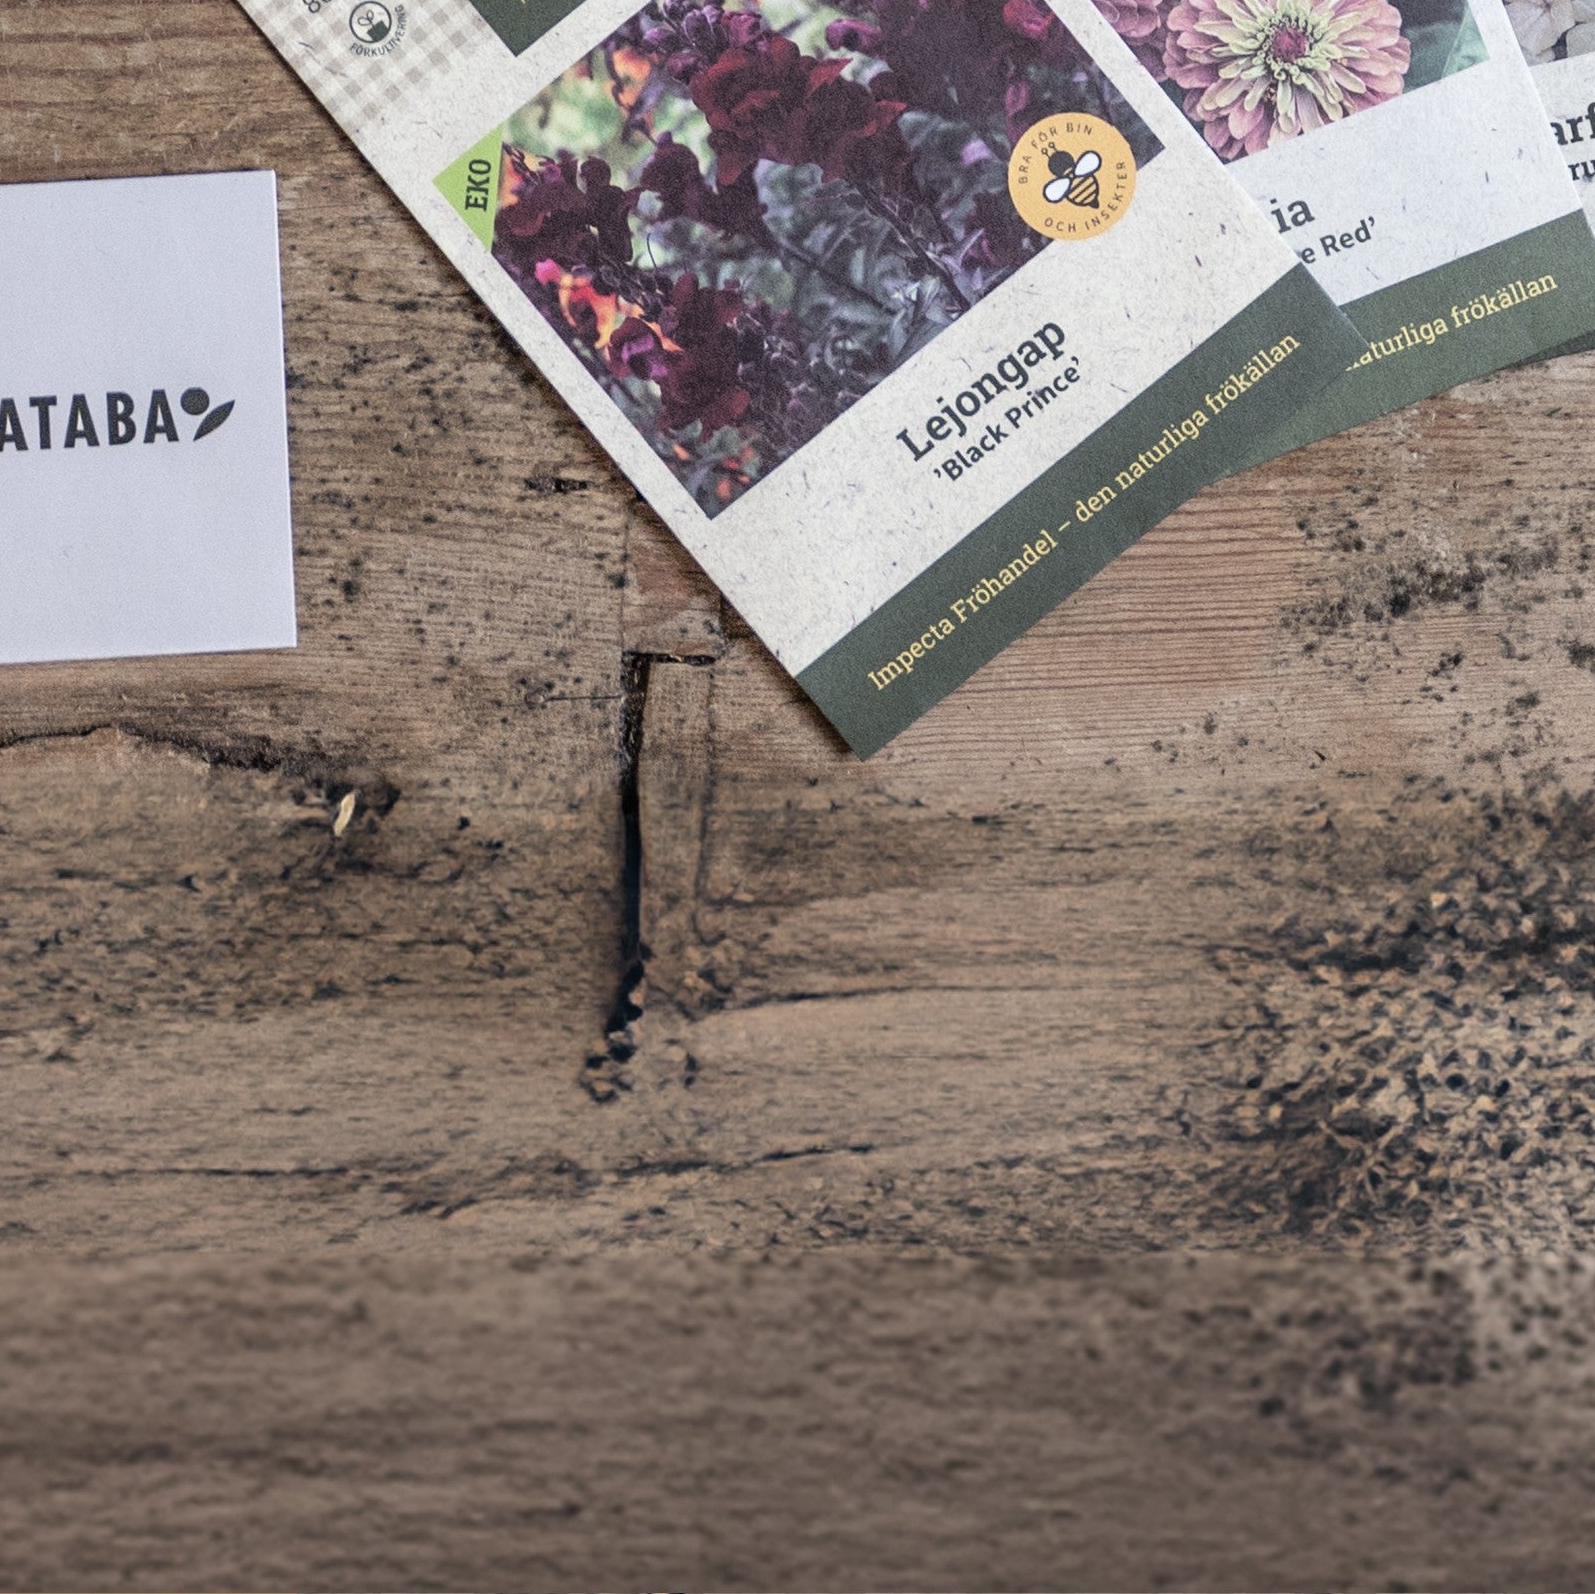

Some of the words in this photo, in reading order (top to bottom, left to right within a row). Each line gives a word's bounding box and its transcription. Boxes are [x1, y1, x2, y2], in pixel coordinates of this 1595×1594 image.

[1066, 122, 1093, 135] BIN
[465, 159, 491, 212] EKO
[1018, 155, 1032, 184] BRA
[1084, 162, 1127, 231] INSEKTER
[1045, 217, 1077, 232] OCH
[1450, 274, 1558, 329] frökällan
[895, 322, 1066, 462] Lejongap
[867, 618, 956, 691] Impecta
[949, 529, 1058, 624] Fröhandel
[1075, 486, 1118, 523] den
[1114, 410, 1210, 491] naturliga
[1204, 335, 1301, 415] frökällan
